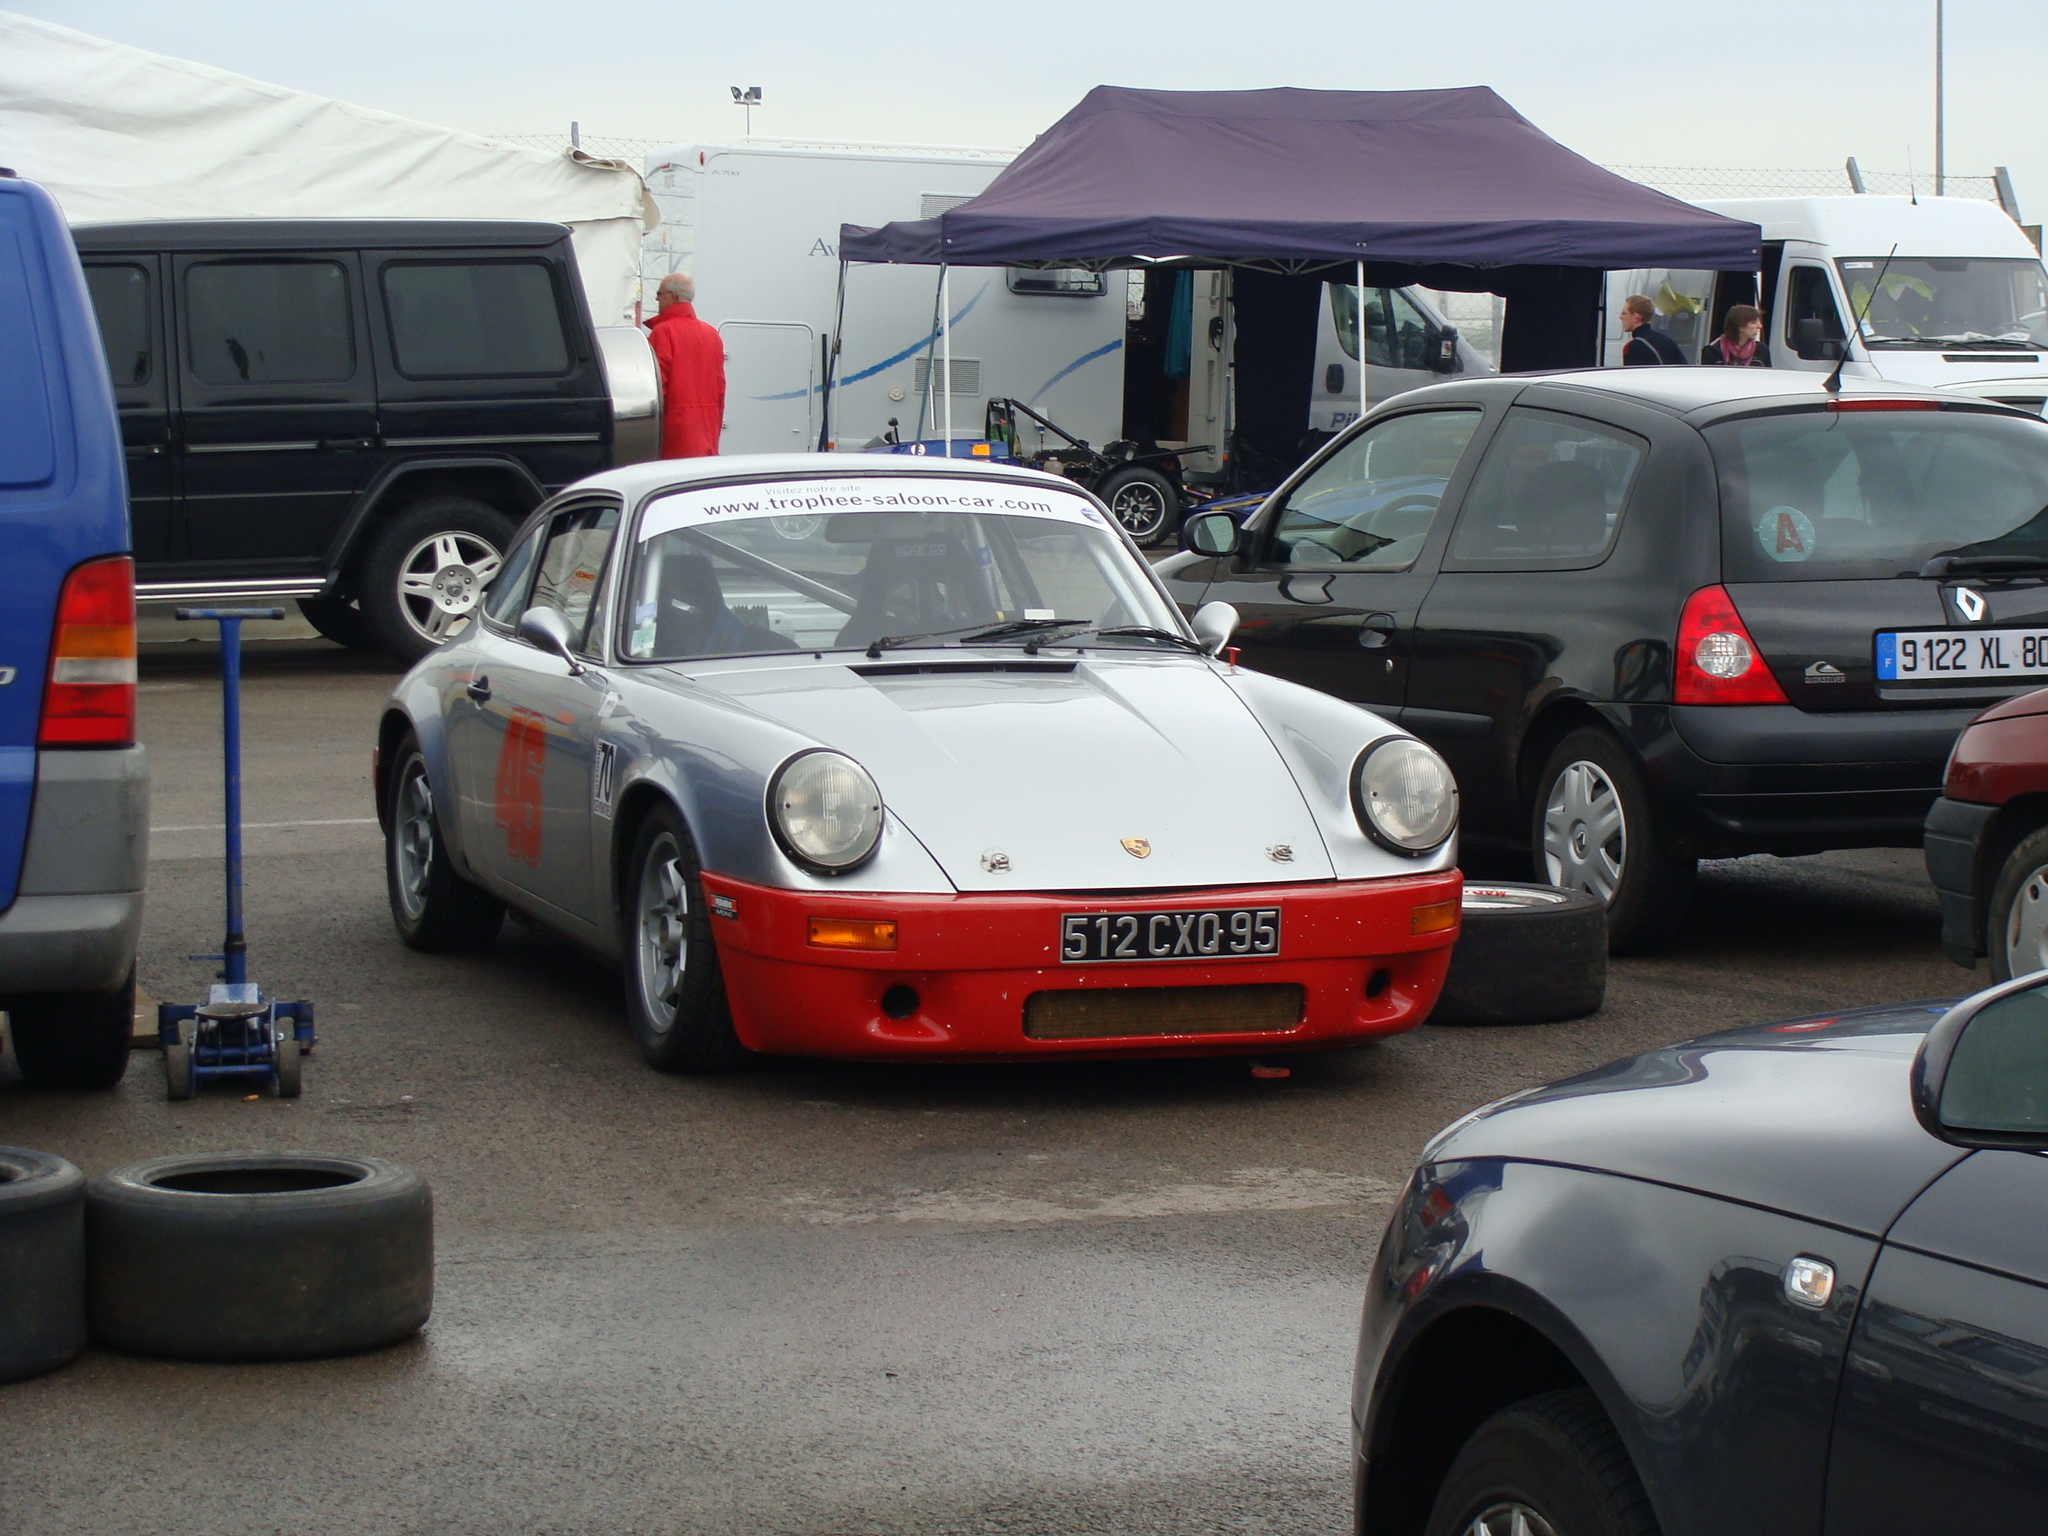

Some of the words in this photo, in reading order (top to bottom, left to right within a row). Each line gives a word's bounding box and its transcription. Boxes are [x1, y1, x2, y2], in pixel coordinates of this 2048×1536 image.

[703, 492, 1053, 516] www.trophee-saloon-car.com
[765, 488, 803, 496] Visitez
[806, 486, 837, 494] notre
[841, 484, 862, 492] site
[1776, 513, 1805, 554] A
[1884, 657, 1892, 668] F
[1902, 638, 1967, 672] 9122
[1980, 636, 2010, 669] XL
[2022, 635, 2048, 667] 80
[597, 742, 614, 803] 70
[1064, 916, 1138, 959] 512
[1149, 912, 1220, 957] CXQ
[1230, 910, 1277, 953] 95
